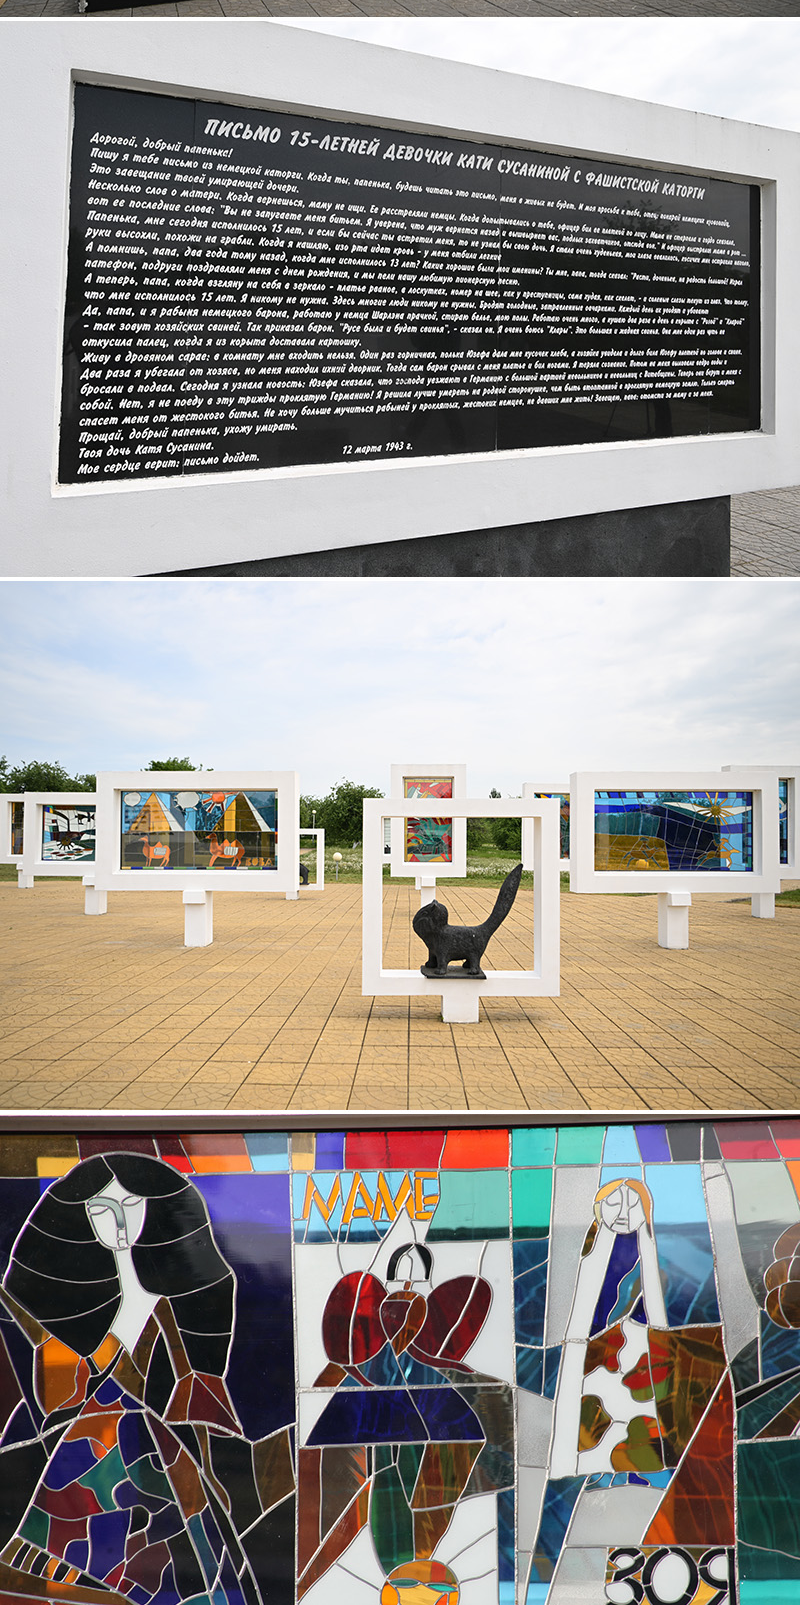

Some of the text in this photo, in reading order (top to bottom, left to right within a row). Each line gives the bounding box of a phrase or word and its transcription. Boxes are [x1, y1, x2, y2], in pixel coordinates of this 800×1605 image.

[89, 131, 233, 157] Дорогой, добрый папенька!
[89, 147, 262, 175] Пишу я тебе письмо из немецкой
[204, 118, 706, 201] ПИСЬМО 15-ЛЕТНЕЙ ДЕВОЧКИ КАТИ СУСАНИНОЙ С ФАШИСТСКОЙ КАТОРГИ
[89, 162, 299, 193] Это завещание твоей умирающей дочери.
[87, 178, 305, 208] Несколько слов о матери. Когда вернешься,
[86, 196, 252, 216] вот ее последние слова: "Вы не
[86, 209, 304, 235] Папенька, мне сегодня исполнилось 15 лет,
[84, 226, 111, 238] руки
[114, 229, 160, 241] высохли,
[164, 232, 202, 242] похожи
[204, 235, 217, 243] на
[219, 234, 254, 246] грабли.
[258, 236, 285, 247] Когда
[286, 240, 293, 248] я
[295, 241, 331, 251] кашляю,
[84, 240, 257, 262] А помнишь, папа, два года тому
[84, 259, 136, 271] патефон,
[141, 259, 183, 273] подруги
[185, 261, 245, 274] поздравляли
[247, 266, 271, 275] меня
[274, 267, 280, 275] с
[282, 265, 304, 276] днем
[306, 267, 350, 279] рождения,
[83, 272, 244, 290] А теперь, папа, когда взгляну
[83, 290, 236, 302] что мне исполнилось 15 лет.
[81, 304, 199, 318] Да, папа, и я рабыня
[92, 320, 262, 333] так зовут хозяйских свиней. Так
[81, 335, 361, 349] откусила палец, когда я из корыта доставала картошку.
[80, 350, 220, 365] Живу в дровяном сарае: в
[79, 365, 203, 380] Два раза я убегала от
[79, 379, 229, 396] бросали в подвал. Сегодня я
[79, 394, 204, 410] собой. Нет, я не поеду
[78, 408, 259, 426] спасет меня от жестокого битья.
[78, 422, 297, 444] Прощай, добрый папенька, ухожу умирать.
[78, 441, 214, 458] Твоя дочь Катя Сусанина.
[76, 451, 259, 474] Мое сердце верит: письмо дойдет.
